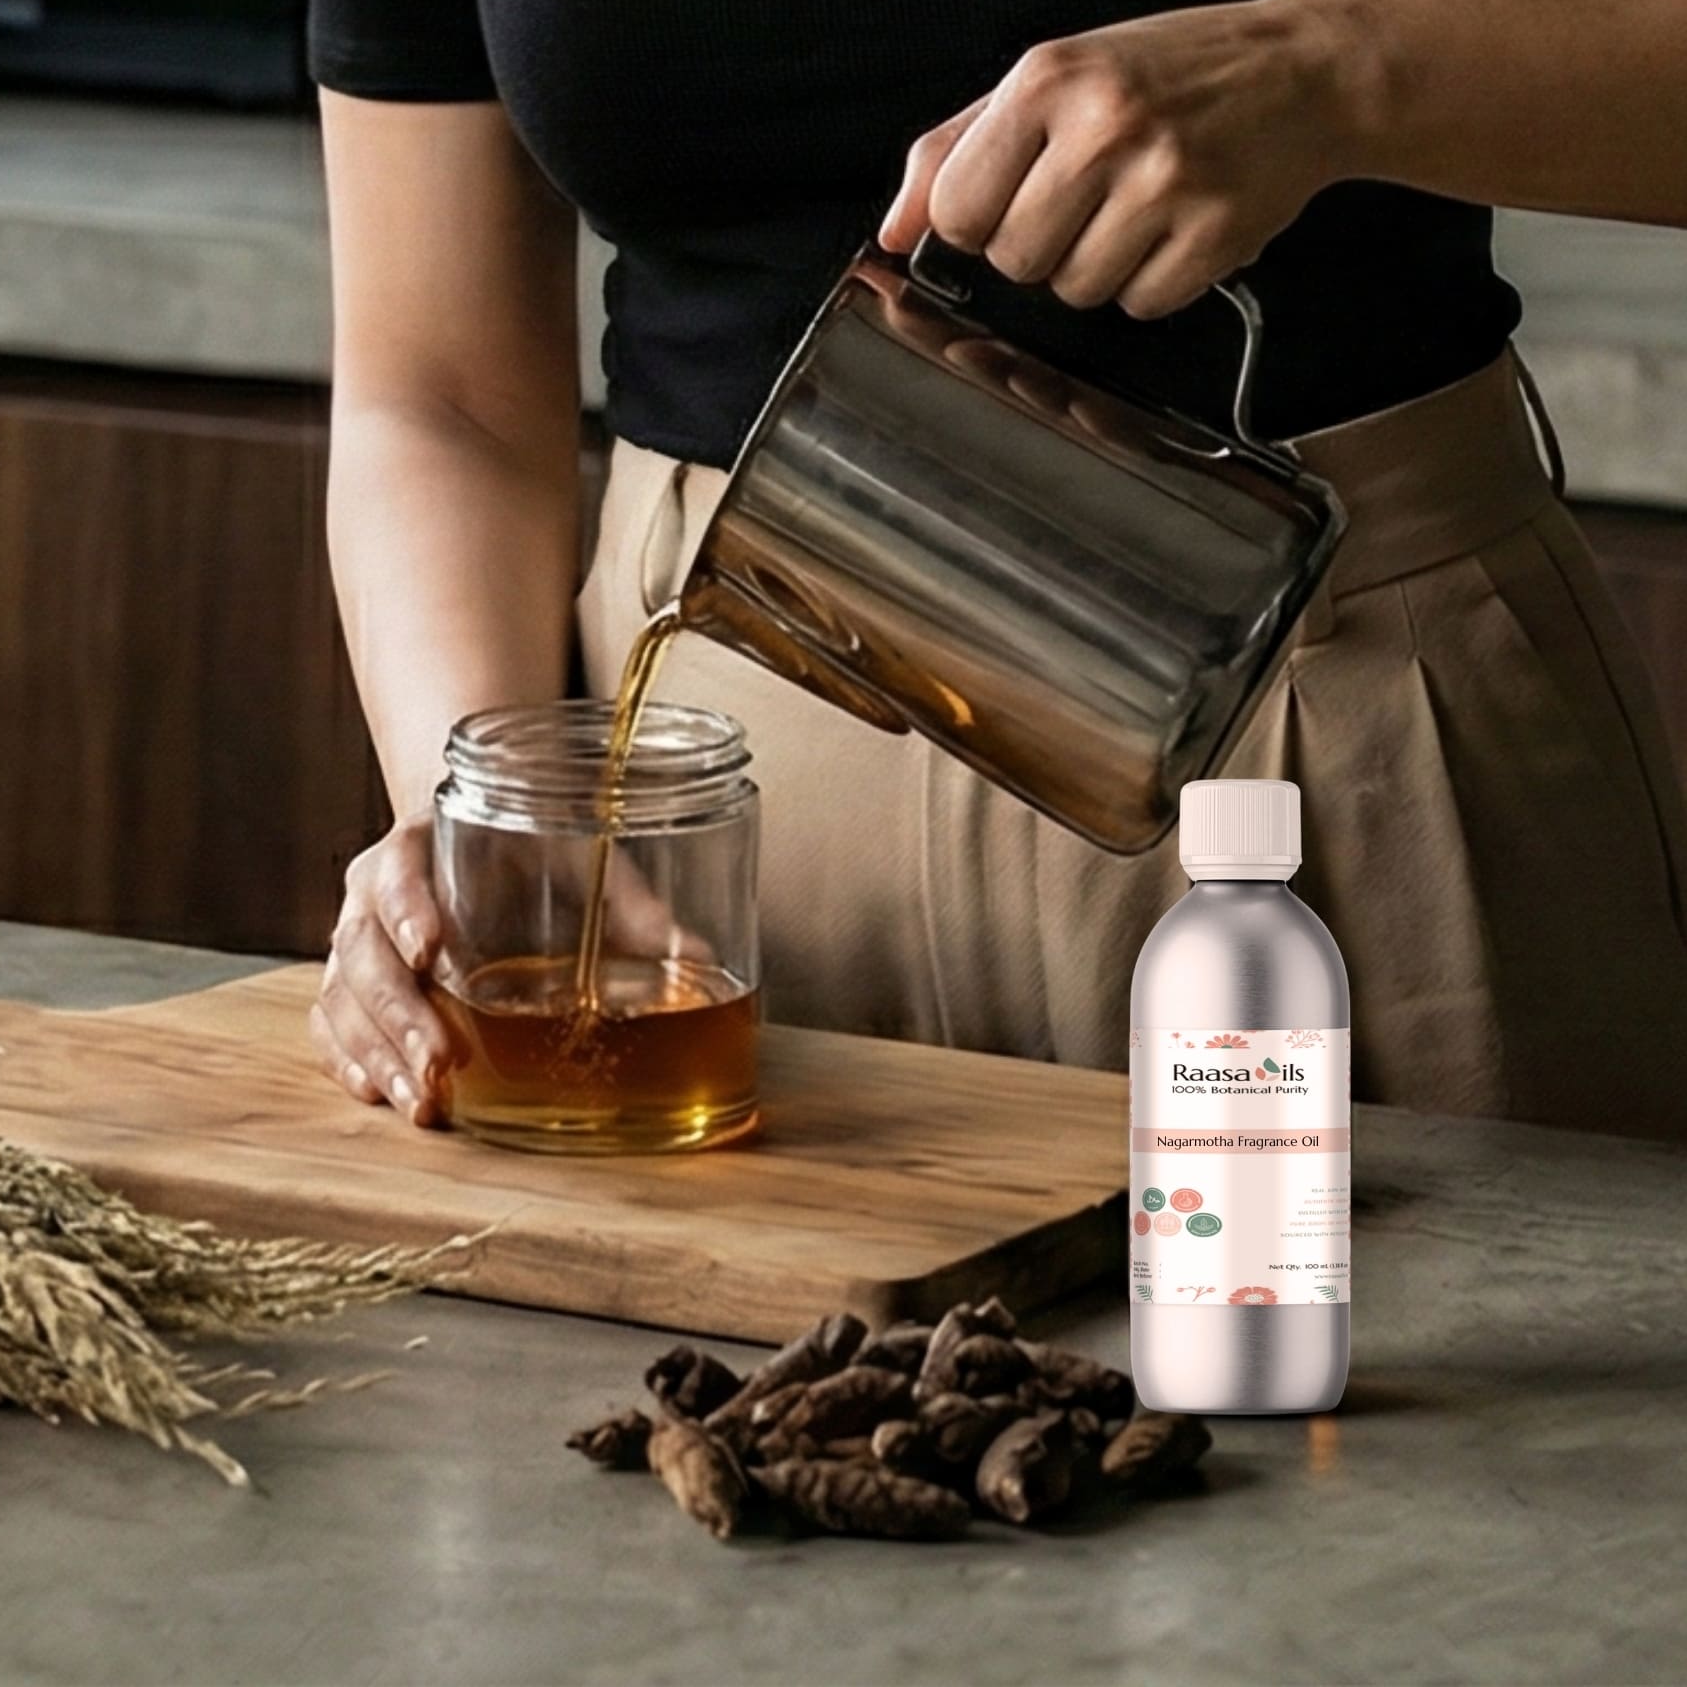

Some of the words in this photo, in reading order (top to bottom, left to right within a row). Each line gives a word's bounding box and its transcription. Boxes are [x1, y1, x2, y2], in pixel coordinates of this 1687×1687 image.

[1172, 1063, 1251, 1082] Raasa
[1171, 1085, 1207, 1095] 100%
[1210, 1085, 1272, 1095] Botanical
[1275, 1085, 1309, 1096] Purity
[1156, 1135, 1234, 1150] Nagarmotha
[1237, 1135, 1298, 1150] Fragrance
[1301, 1135, 1319, 1147] Oil
